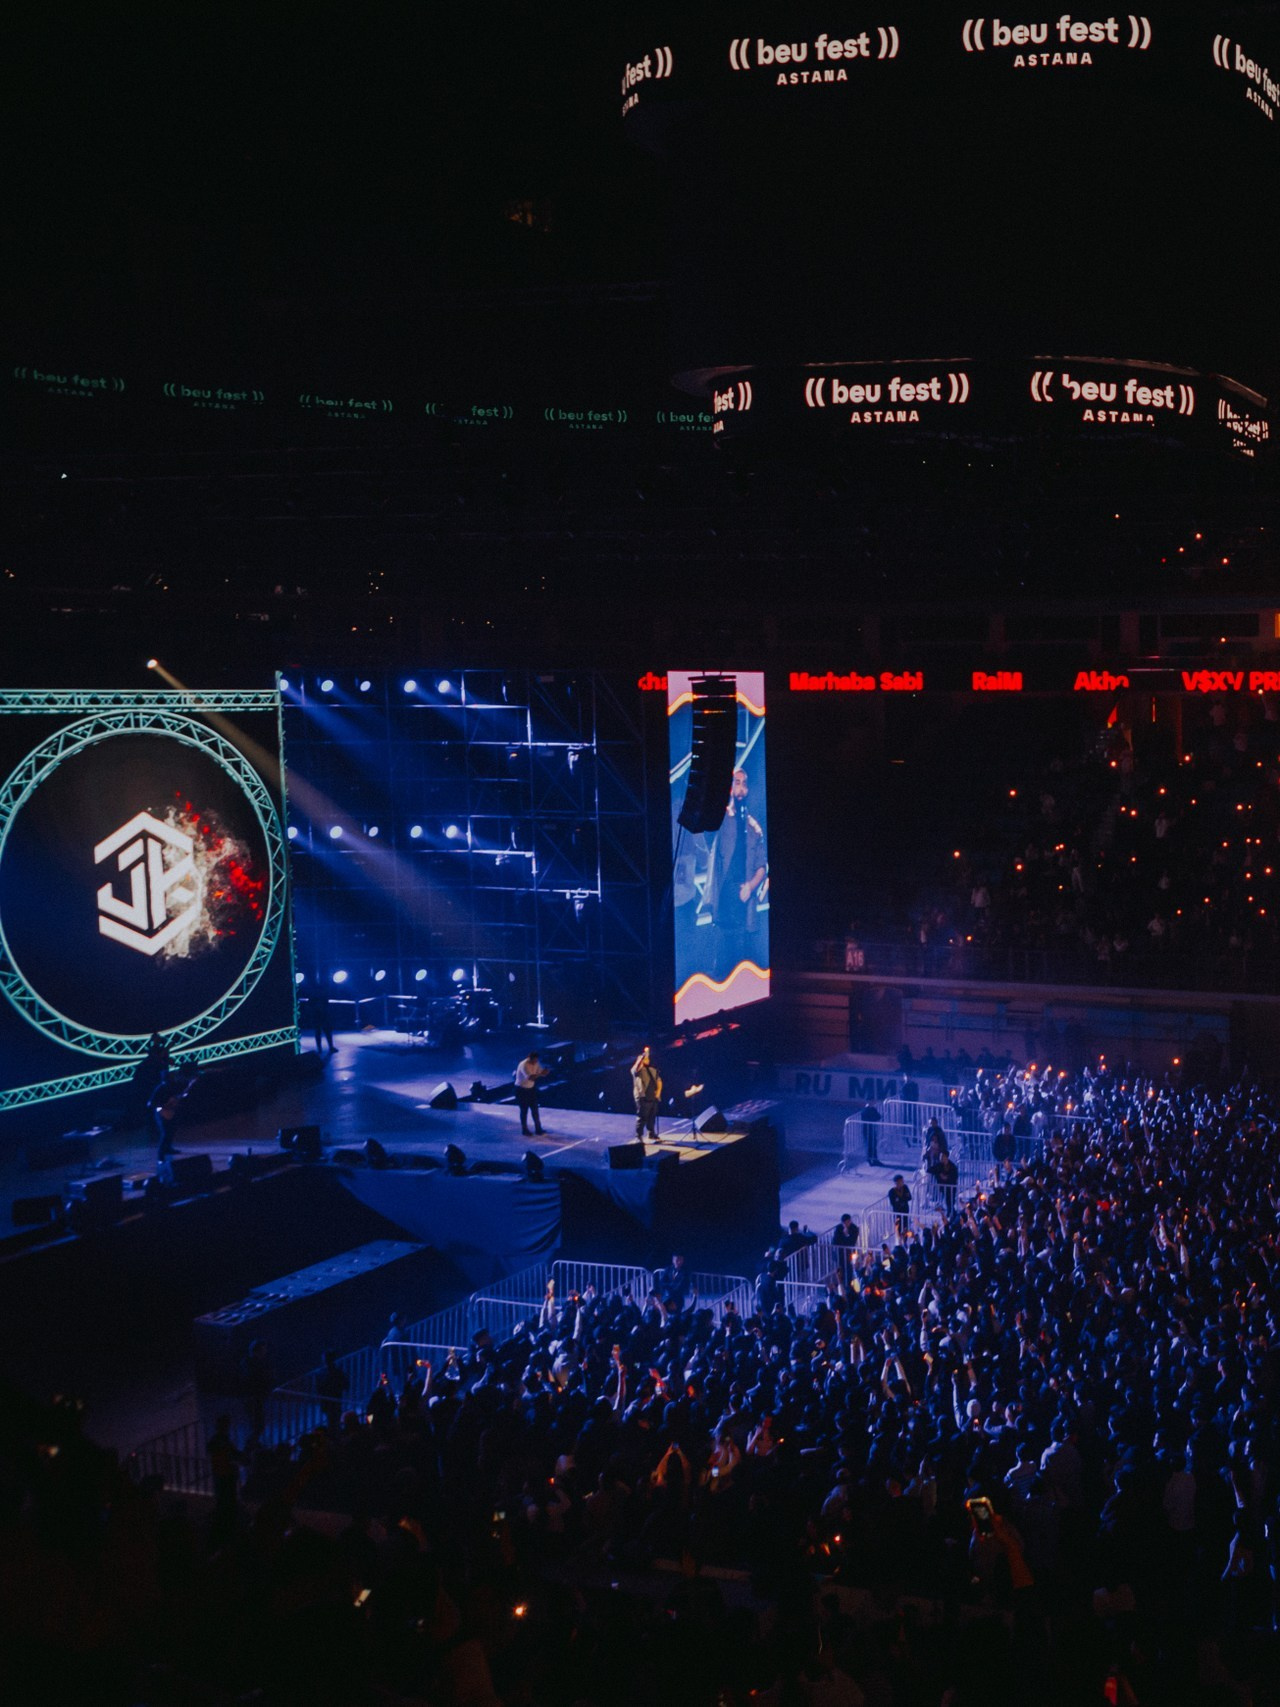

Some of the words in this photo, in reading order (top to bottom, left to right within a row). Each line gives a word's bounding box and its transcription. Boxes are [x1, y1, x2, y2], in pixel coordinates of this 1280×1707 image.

[992, 18, 1048, 46] beu
[1056, 14, 1119, 44] fest
[756, 37, 808, 66] beu
[815, 32, 870, 61] fest
[1013, 52, 1093, 68] ASTANA
[625, 54, 652, 89] fest
[776, 68, 848, 86] ASTANA
[1235, 43, 1262, 85] beu
[1262, 67, 1280, 108] fest
[1246, 86, 1274, 121] ASTANA
[181, 385, 212, 400] beu
[832, 378, 882, 404] beu
[888, 375, 942, 403] fest
[1124, 378, 1175, 409] fest
[471, 405, 500, 418] fest
[558, 408, 584, 421] beu
[587, 409, 614, 422] fest
[670, 411, 694, 423] beu
[851, 410, 920, 424] ASTANA
[789, 671, 876, 691] Marhaba
[880, 671, 923, 691] Sabi
